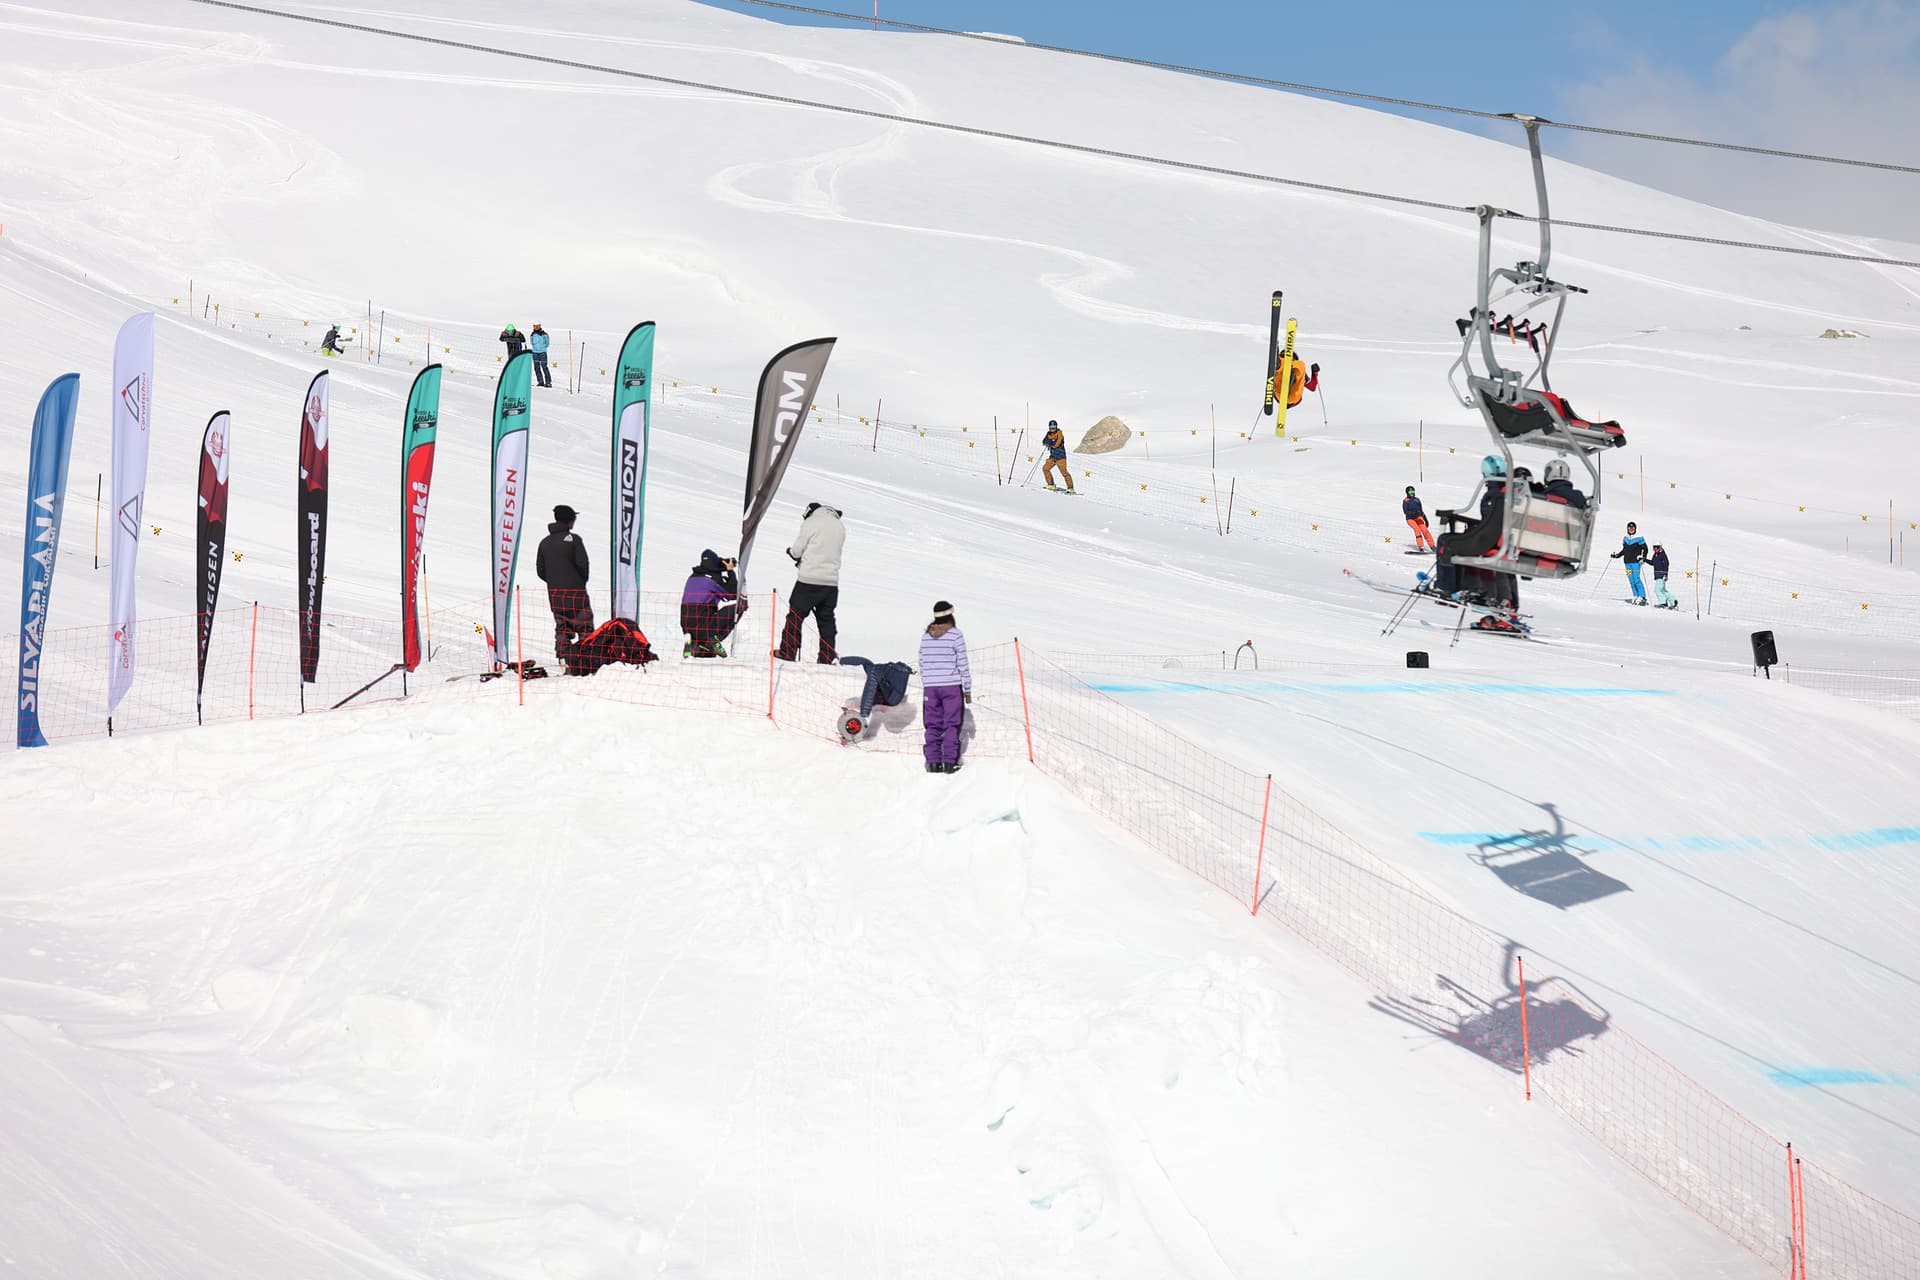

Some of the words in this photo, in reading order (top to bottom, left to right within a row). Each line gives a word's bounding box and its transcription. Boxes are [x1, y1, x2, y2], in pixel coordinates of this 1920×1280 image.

[499, 468, 518, 594] RAIFFEISEN
[621, 443, 637, 560] FACTION
[21, 492, 56, 713] SILVAPLANA
